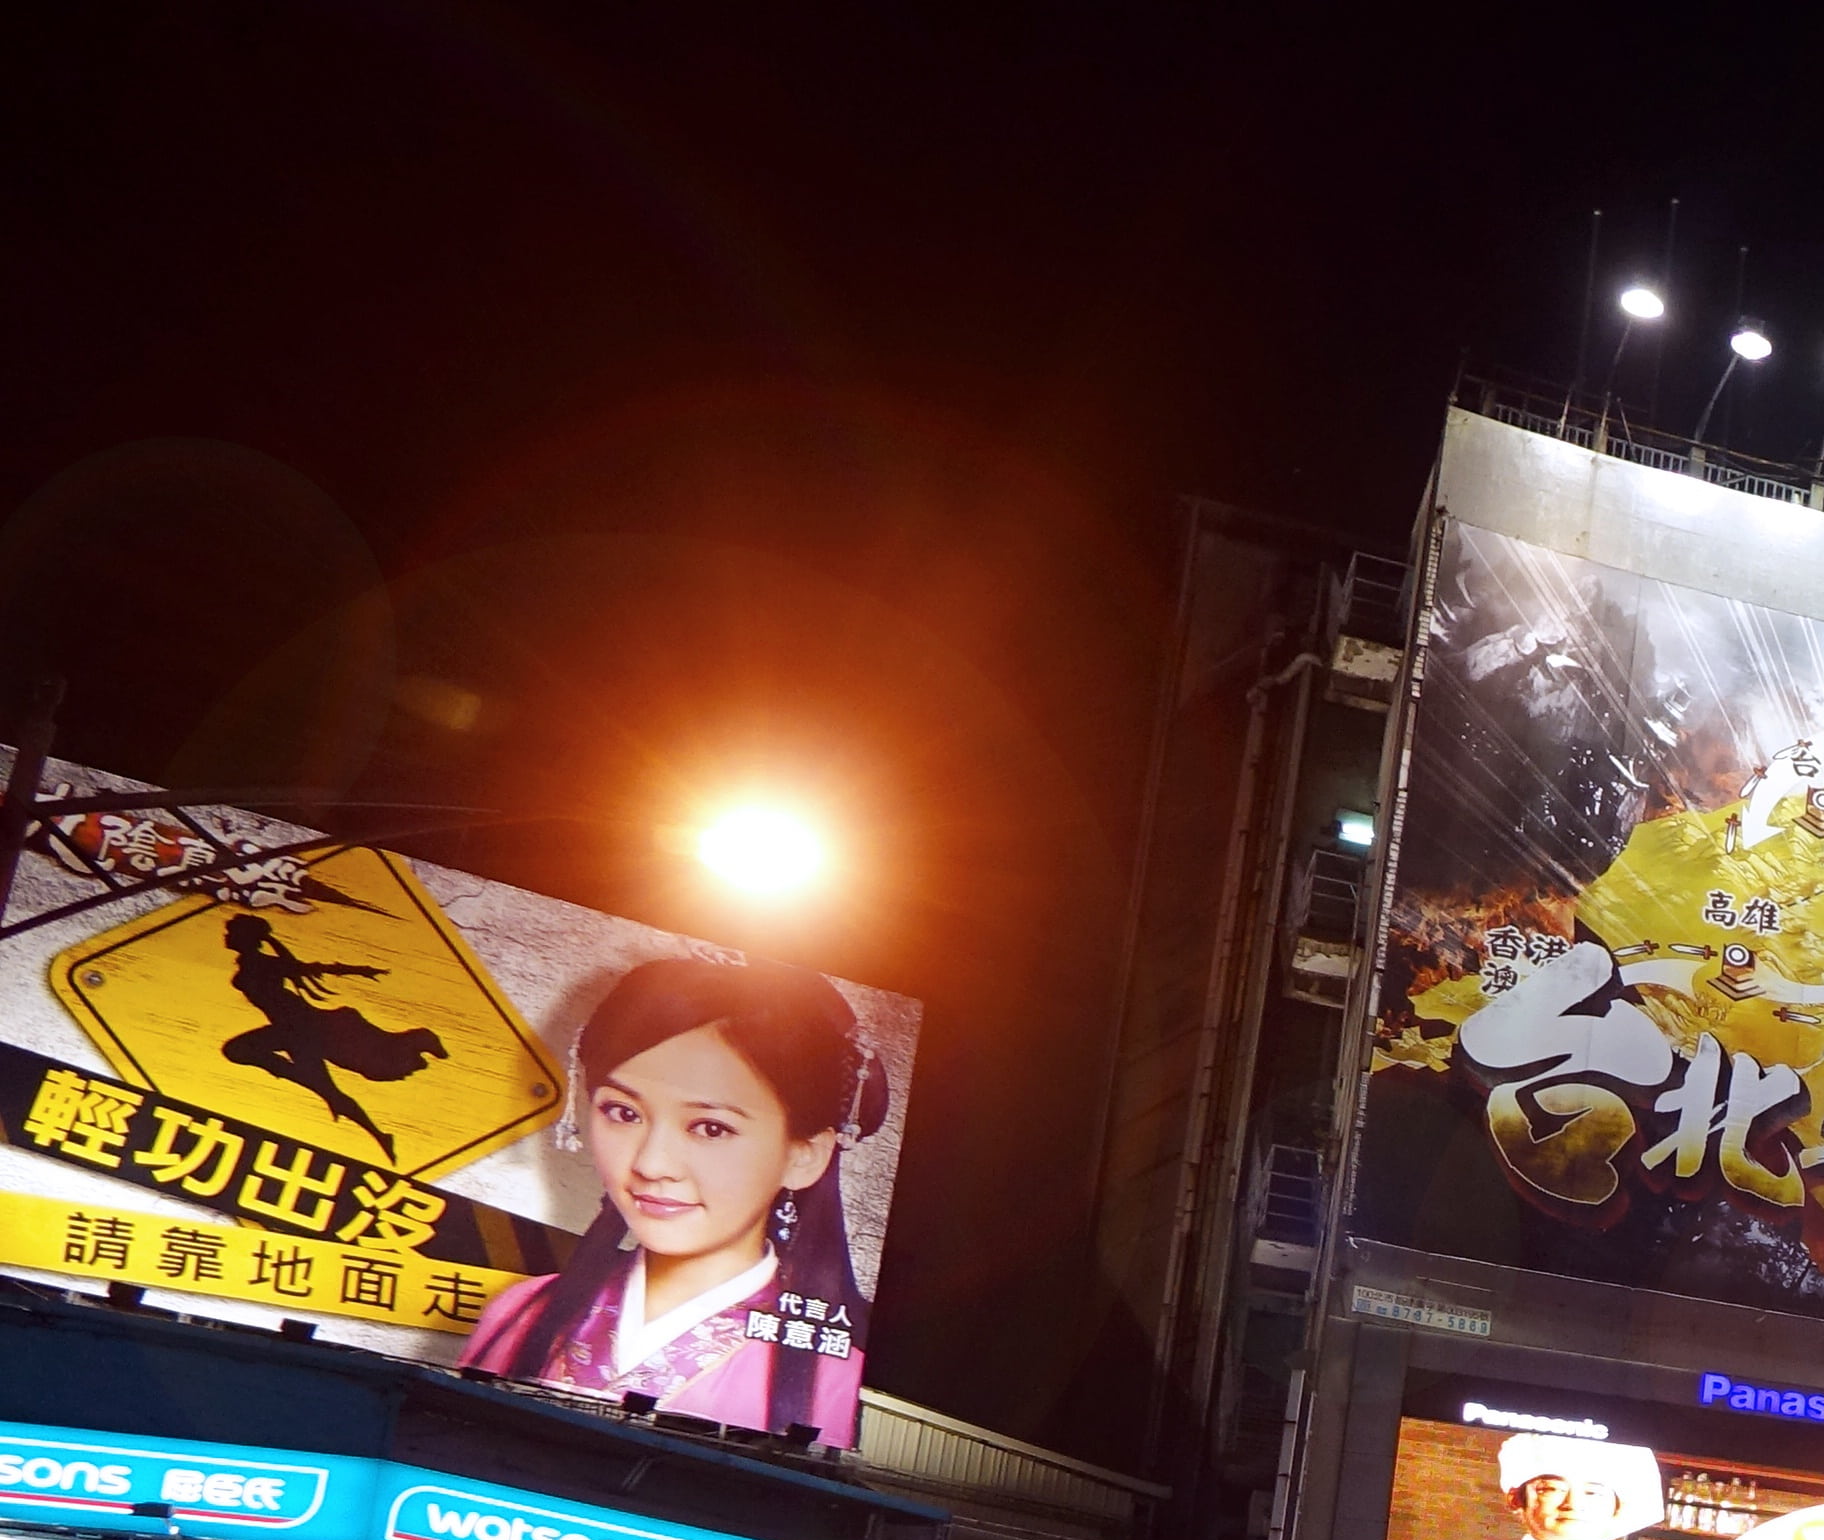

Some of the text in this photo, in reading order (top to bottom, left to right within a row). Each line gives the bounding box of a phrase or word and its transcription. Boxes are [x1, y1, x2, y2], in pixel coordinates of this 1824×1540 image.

[1703, 889, 1782, 936] 高雄
[22, 1068, 448, 1262] 輕功出沒
[62, 1210, 490, 1325] 請靠地面走
[778, 1290, 853, 1327] 代言人
[743, 1308, 852, 1361] 陳意涵
[160, 1468, 288, 1515] 屈臣氏
